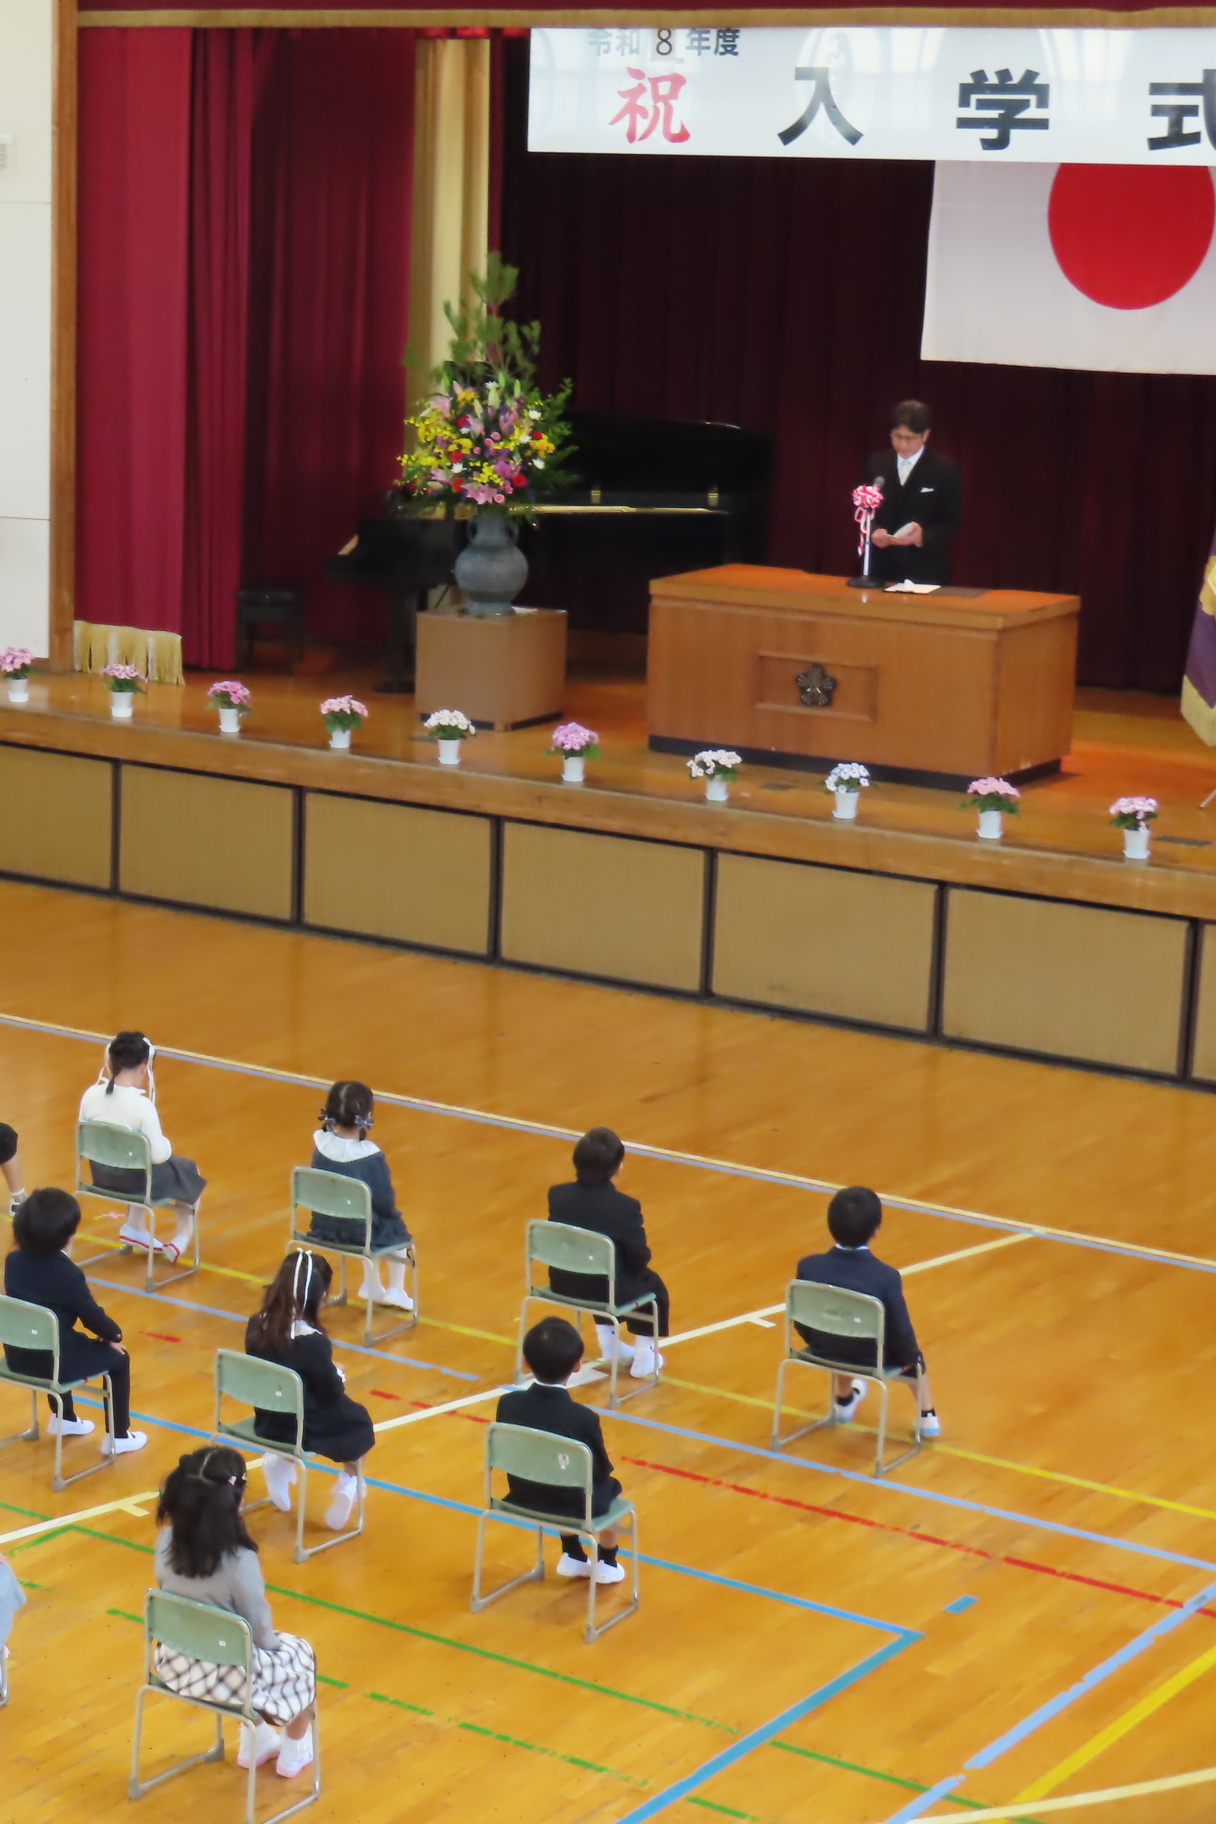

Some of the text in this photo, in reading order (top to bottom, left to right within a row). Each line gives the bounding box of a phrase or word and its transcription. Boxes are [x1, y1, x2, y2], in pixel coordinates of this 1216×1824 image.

[588, 28, 740, 57] 令和8年度
[608, 66, 1216, 151] 祝 入学式
